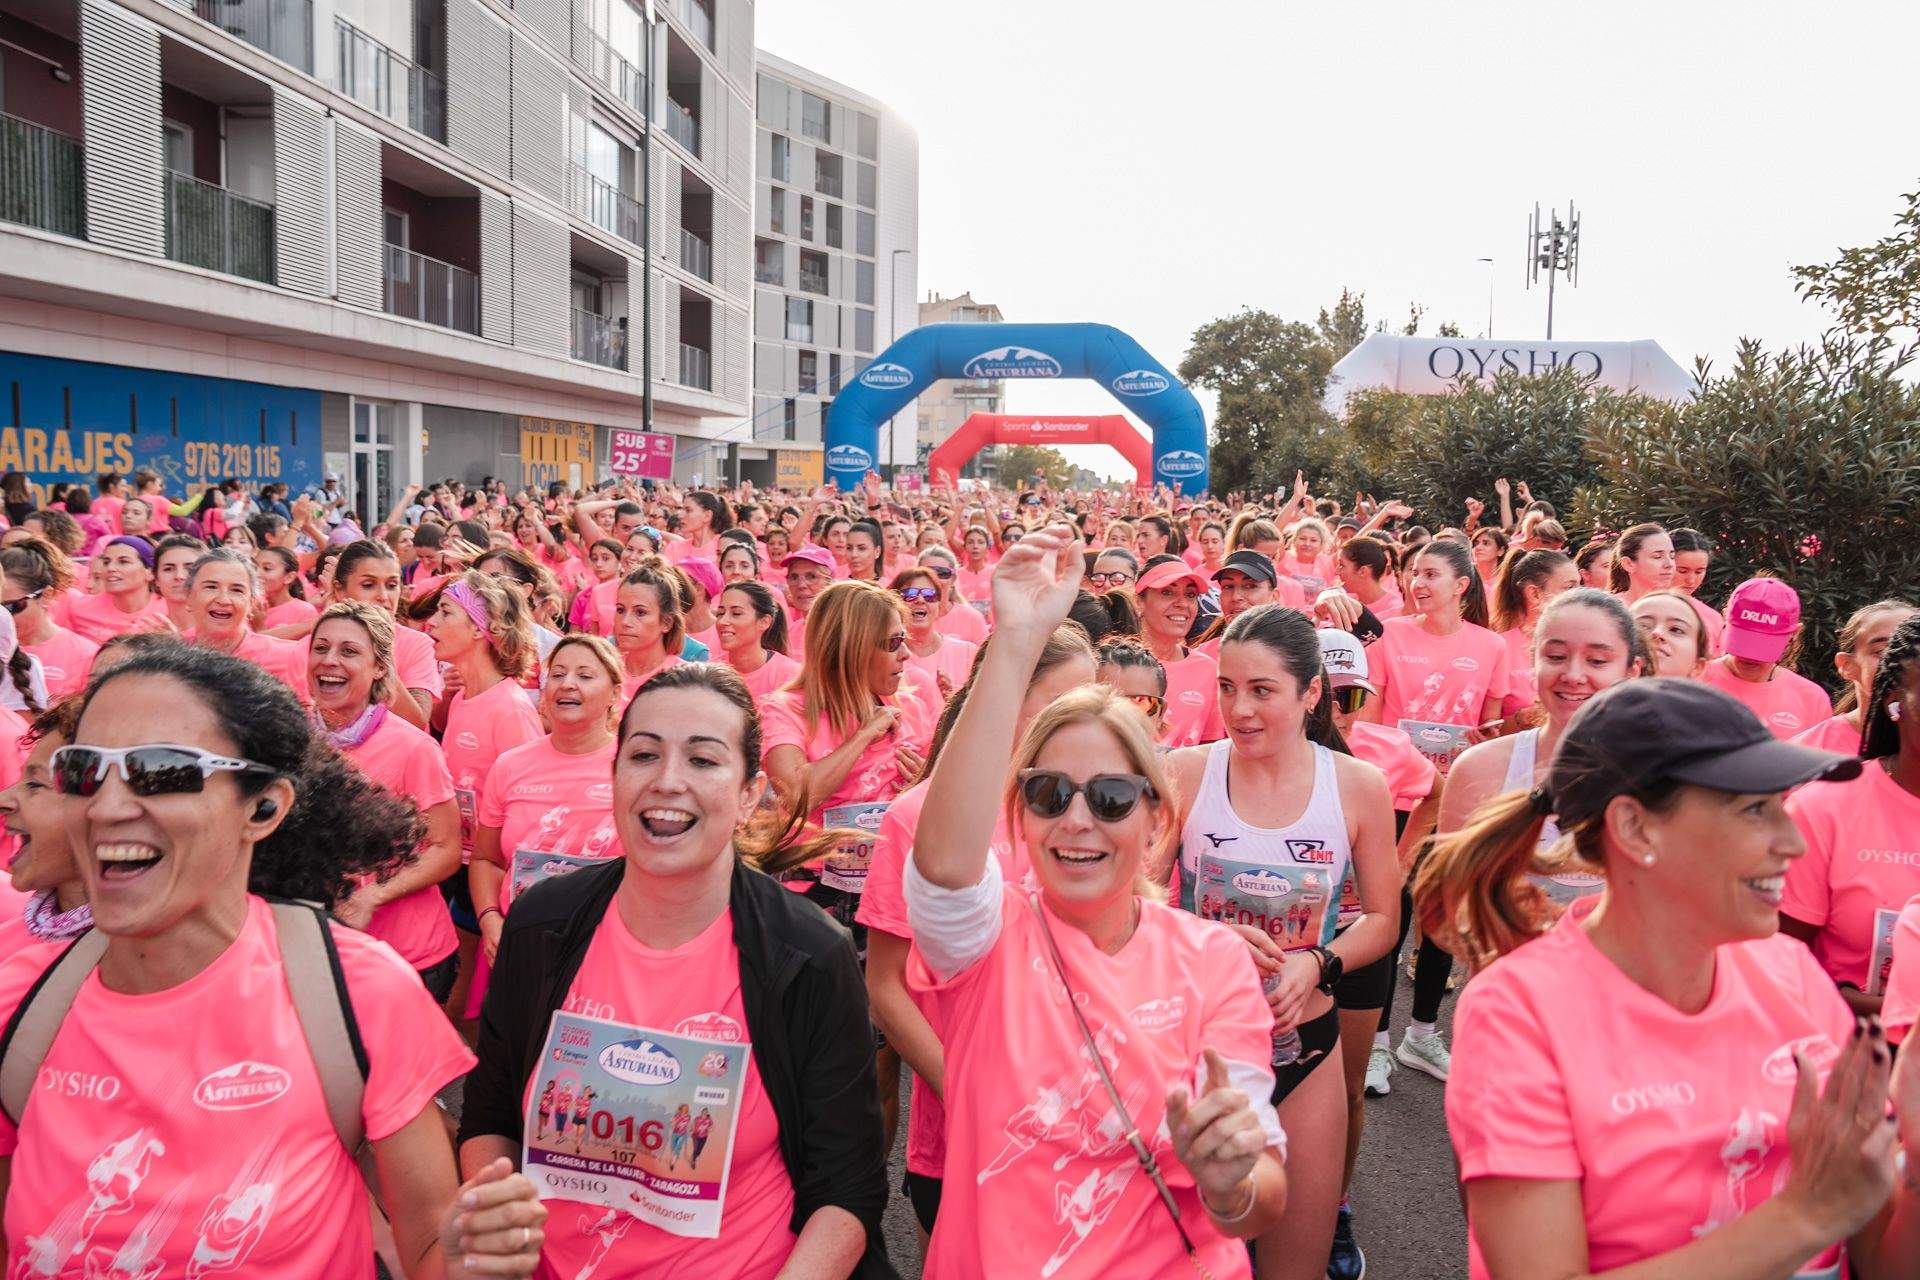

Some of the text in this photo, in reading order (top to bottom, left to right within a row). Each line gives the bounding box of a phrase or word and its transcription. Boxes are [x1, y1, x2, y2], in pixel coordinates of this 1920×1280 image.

[973, 363, 1055, 377] ASTURIANA
[1428, 346, 1603, 381] OYSHO
[864, 373, 909, 383] ASTURIANA
[1118, 380, 1165, 390] ASTURIANA
[1002, 421, 1089, 432] Sports Santander
[0, 427, 134, 475] ARAJES
[615, 433, 646, 449] SUB
[184, 441, 220, 478] 976
[223, 443, 252, 478] 219
[255, 445, 281, 478] 115
[1161, 460, 1202, 471] ASTURIANA
[1740, 609, 1779, 625] DRUNI
[514, 784, 554, 794] OYSHO
[1236, 877, 1288, 893] ASTURIANA
[1238, 909, 1284, 936] 016
[602, 1049, 675, 1080] ASTURIANA
[203, 1079, 284, 1103] ASTURIANA
[1611, 1081, 1697, 1115] OYSHO
[590, 1110, 665, 1151] 016
[611, 1149, 637, 1164] 107
[545, 1153, 700, 1196] CARRERA DE LA MUJER ZARAGOZA
[545, 1172, 608, 1194] OYSHO
[641, 1197, 697, 1222] Santander
